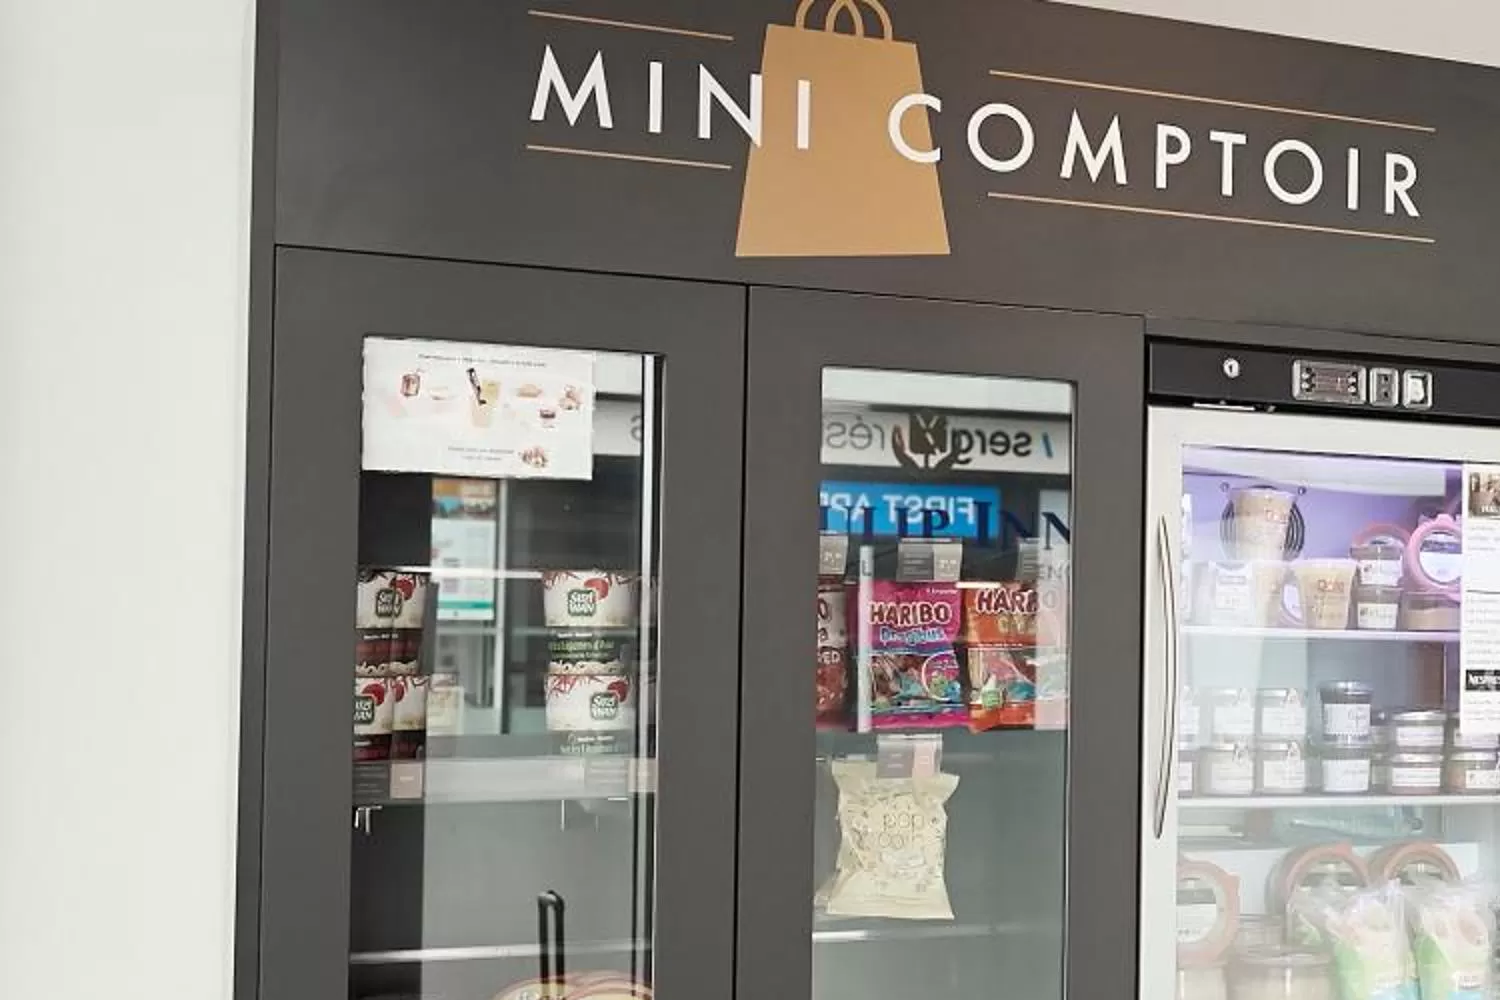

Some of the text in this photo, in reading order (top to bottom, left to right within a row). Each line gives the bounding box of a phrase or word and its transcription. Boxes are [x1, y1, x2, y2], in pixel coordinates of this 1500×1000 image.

[530, 44, 1421, 218] MINI COMPTOIR
[868, 601, 952, 626] HARIBO
